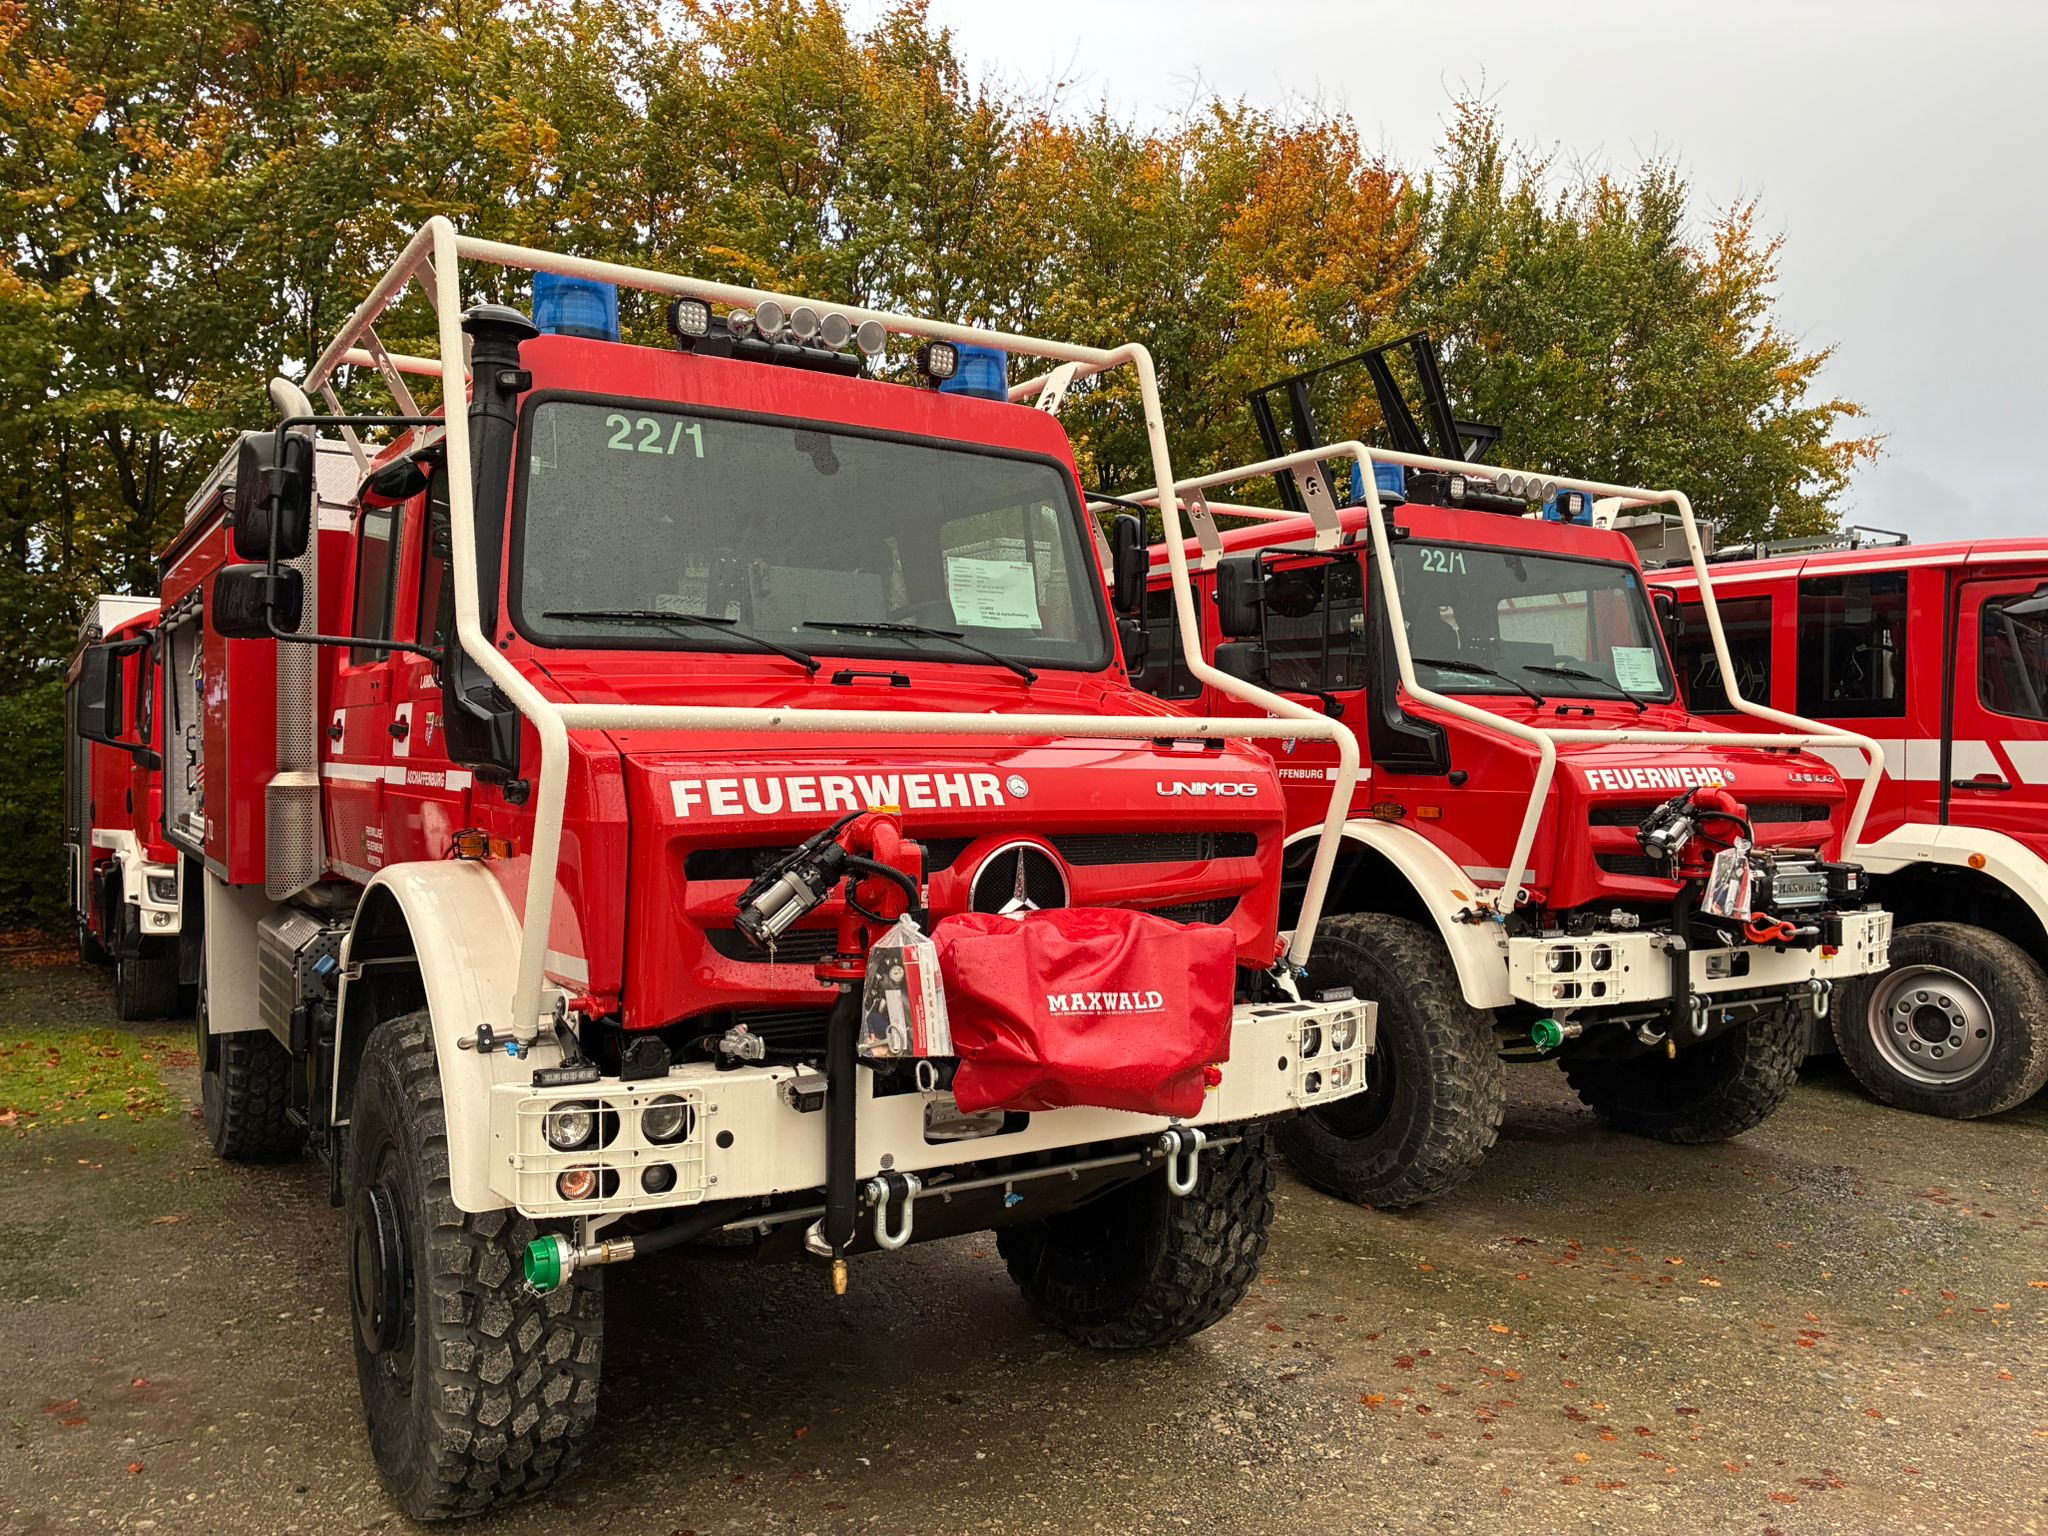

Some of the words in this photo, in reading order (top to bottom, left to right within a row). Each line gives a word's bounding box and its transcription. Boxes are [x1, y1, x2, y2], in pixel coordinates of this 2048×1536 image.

[606, 414, 704, 458] 22/1
[1420, 549, 1466, 575] 22/1
[407, 770, 445, 787] ASCHAFFENBURG
[1279, 769, 1324, 779] FFENBURG
[1584, 767, 1728, 790] FEUERWEHR
[669, 773, 1006, 818] FEUERWEHR
[1156, 782, 1258, 796] UNIMOG
[1047, 991, 1163, 1012] MAXWALD
